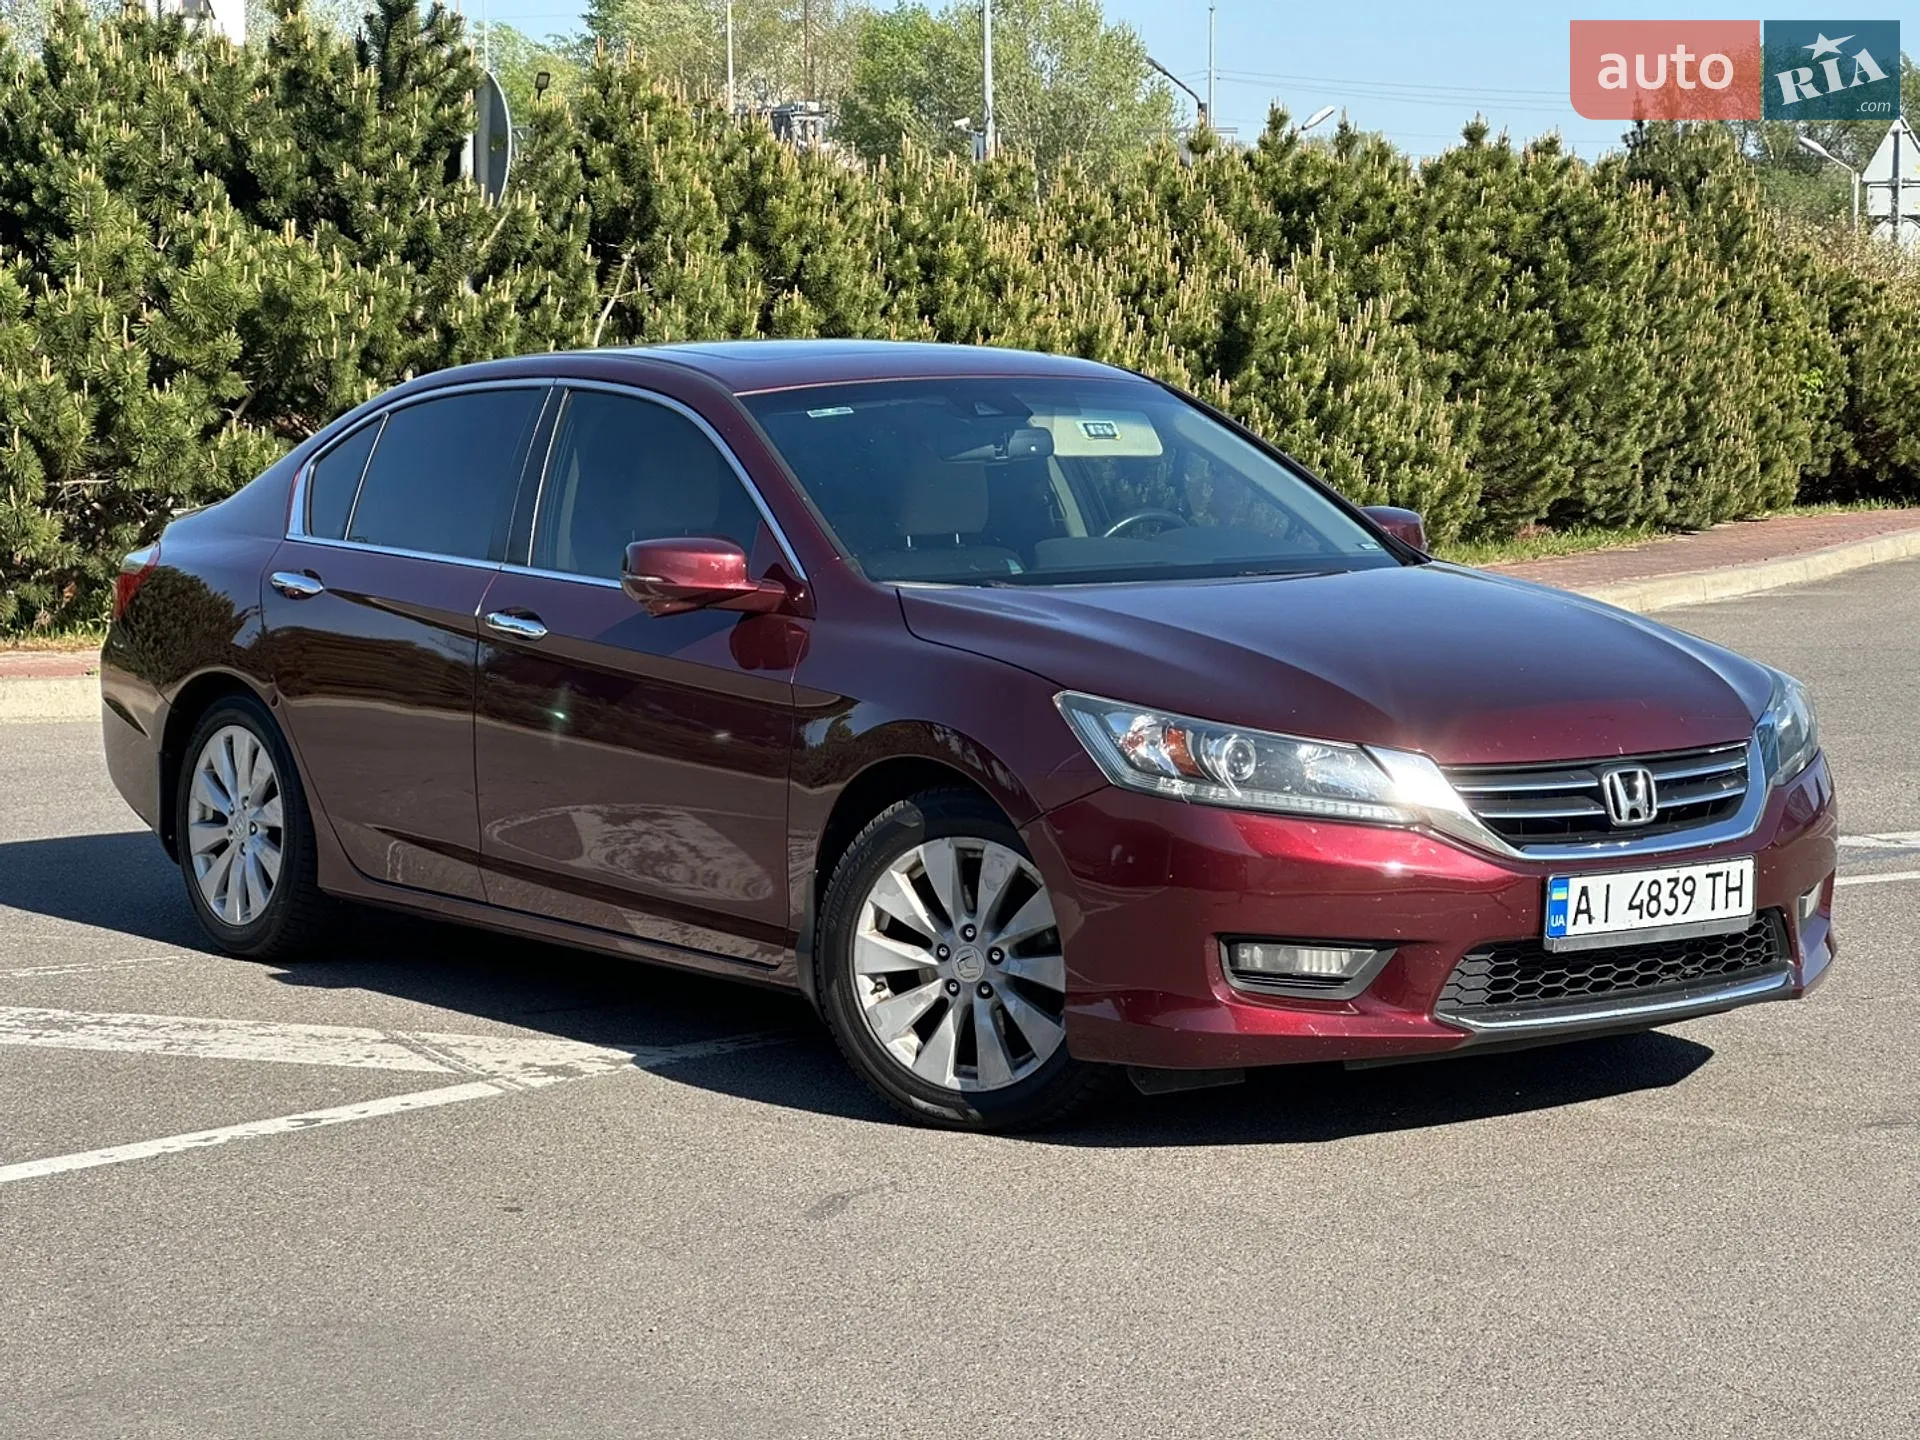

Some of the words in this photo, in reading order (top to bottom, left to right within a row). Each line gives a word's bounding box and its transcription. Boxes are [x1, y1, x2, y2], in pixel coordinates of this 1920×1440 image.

[1572, 884, 1610, 925] AI
[1628, 876, 1697, 919] 4839
[1705, 868, 1744, 911] TH
[1550, 914, 1566, 928] UA
